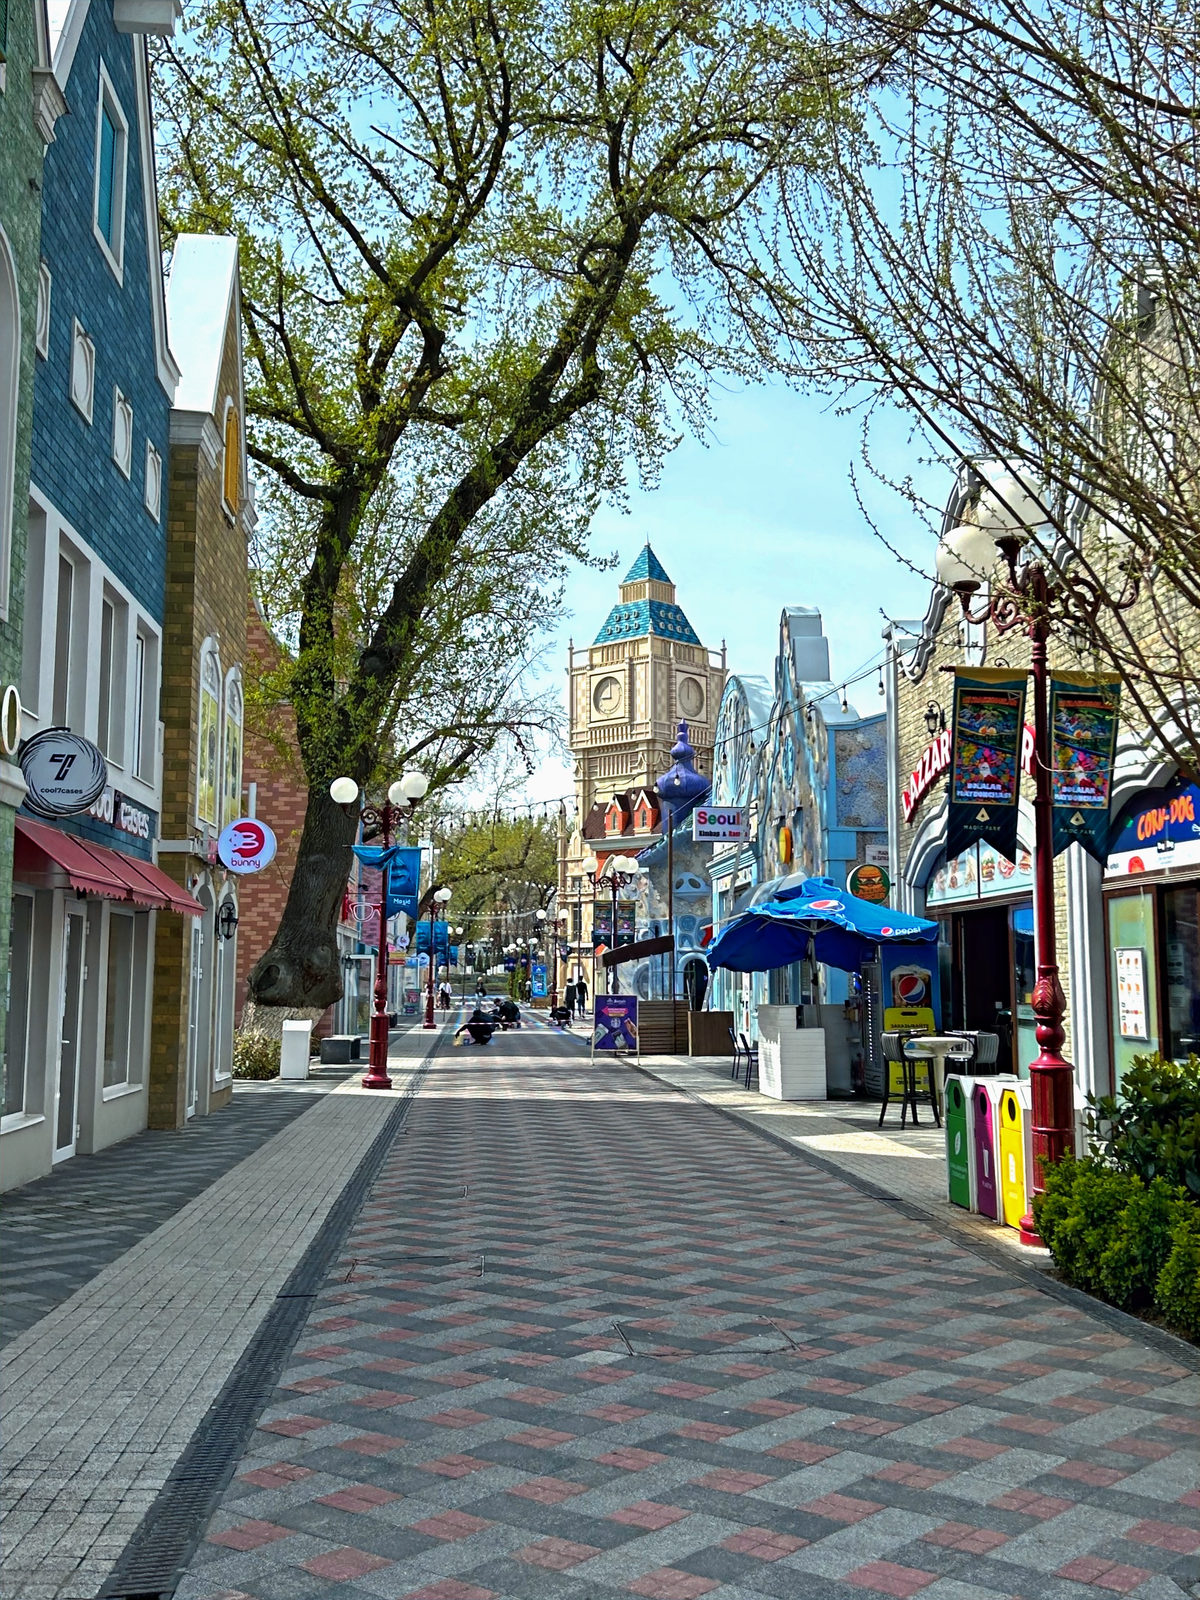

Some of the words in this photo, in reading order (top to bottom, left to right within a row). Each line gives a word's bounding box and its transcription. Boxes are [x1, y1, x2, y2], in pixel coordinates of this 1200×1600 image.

[697, 811, 741, 825] Seoul
[231, 858, 261, 868] bunny
[895, 926, 922, 935] pepsi
